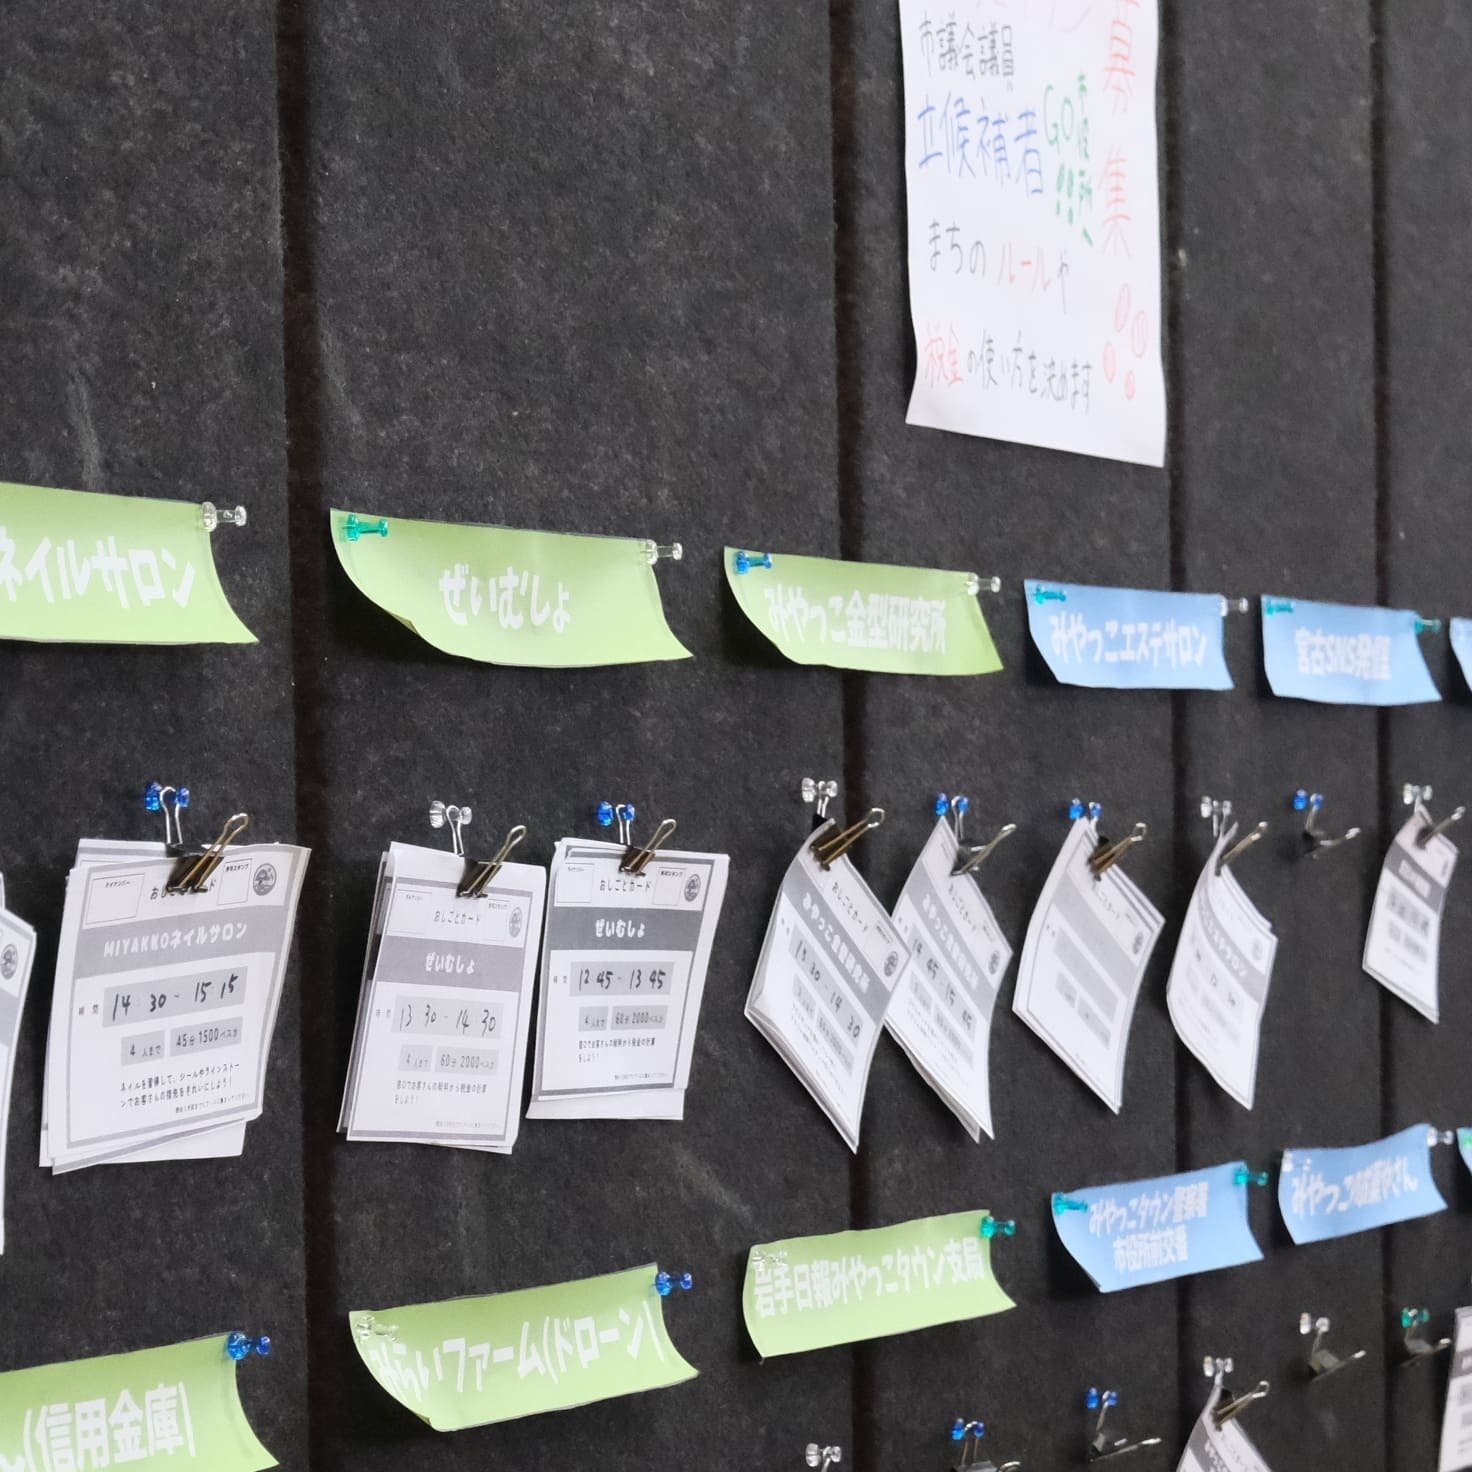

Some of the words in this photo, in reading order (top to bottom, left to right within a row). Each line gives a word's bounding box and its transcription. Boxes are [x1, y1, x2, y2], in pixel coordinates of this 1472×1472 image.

[917, 91, 1045, 200] 立候補者
[438, 564, 573, 633] ぜいむしょ
[764, 582, 948, 655] みやっこ金型研究所
[1049, 610, 1206, 670] みやっこエステサロン
[599, 879, 652, 893] おしごとカード
[103, 922, 249, 958] MIYAKKOネイルサロン
[594, 919, 646, 939] ぜいむしょ
[424, 953, 476, 974] ぜいむしょ
[579, 968, 589, 992] 12
[596, 970, 614, 990] 45
[629, 968, 642, 989] 13
[112, 993, 132, 1022] 14
[148, 993, 167, 1013] 30
[194, 980, 211, 1004] 15
[220, 973, 239, 1000] 15
[399, 1004, 413, 1032] 13
[424, 1004, 437, 1026] 30
[456, 1009, 470, 1035] 14
[481, 1009, 496, 1038] 30
[753, 1236, 984, 1319] 岩手日報みやっこタウン支局
